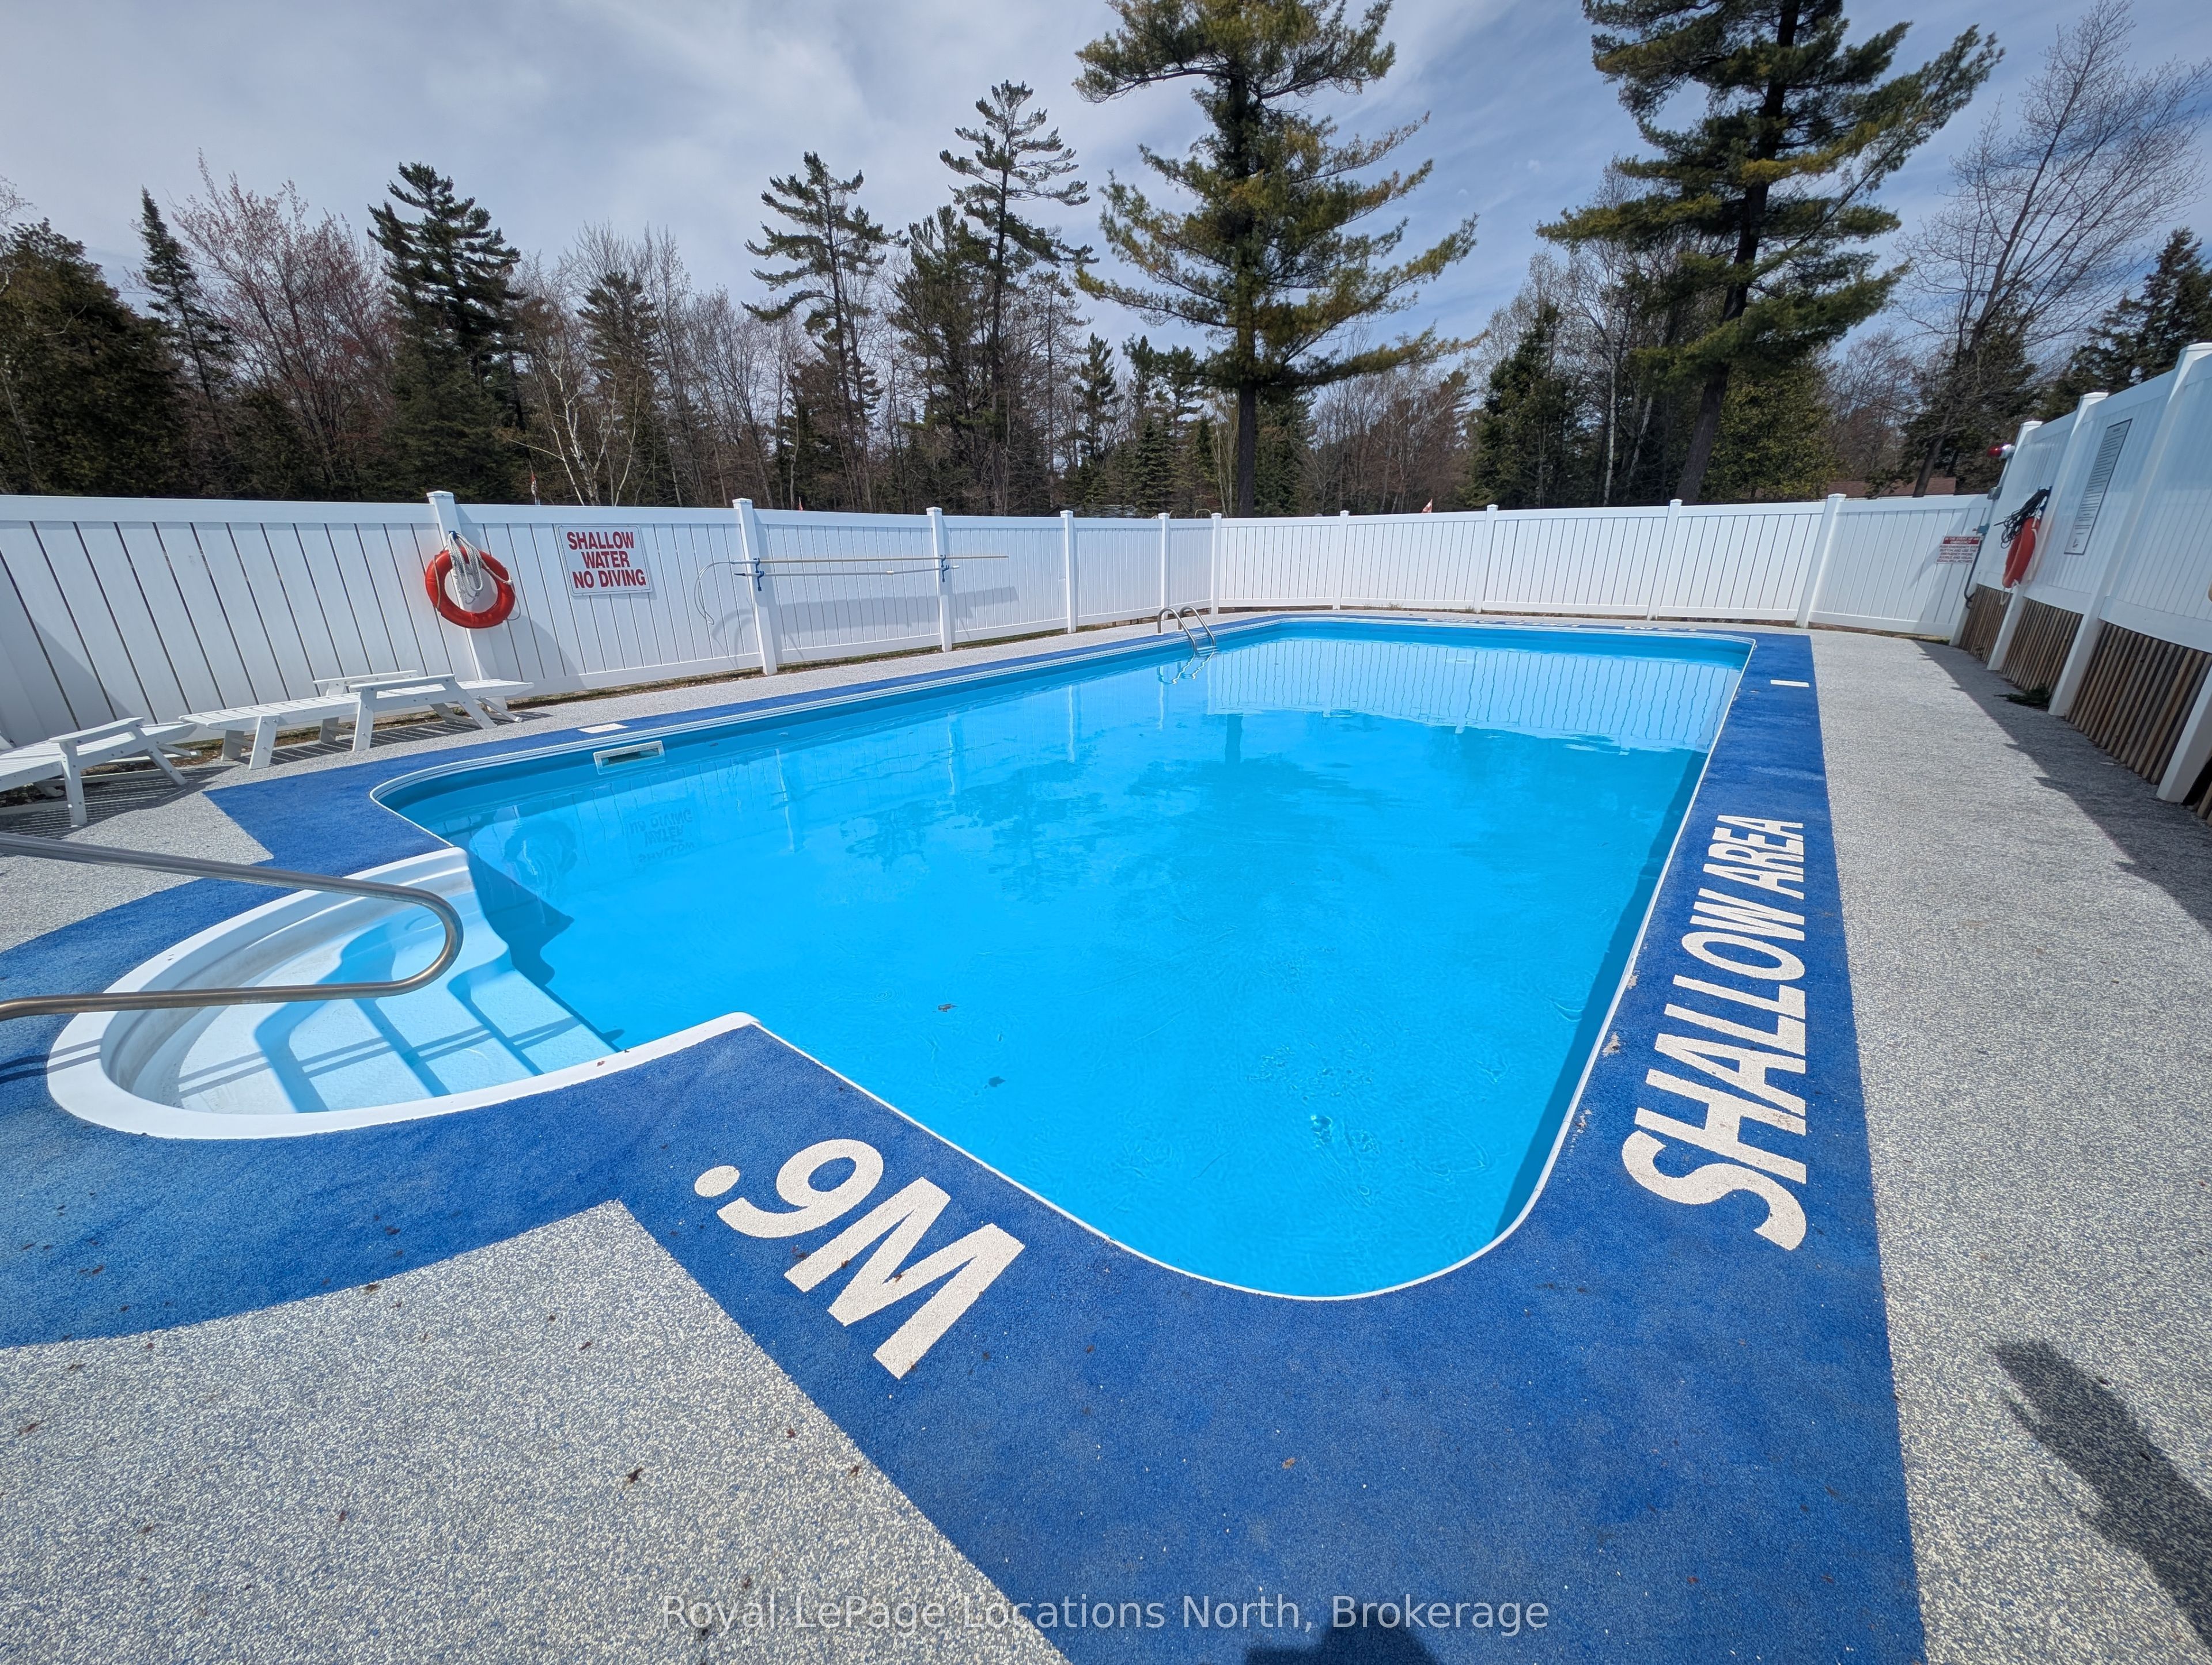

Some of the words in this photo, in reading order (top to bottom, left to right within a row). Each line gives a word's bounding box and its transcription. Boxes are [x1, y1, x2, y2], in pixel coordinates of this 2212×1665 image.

[566, 531, 635, 550] SHALLOW
[581, 551, 631, 568] WATER
[572, 570, 595, 589] NO
[597, 568, 647, 587] DIVING
[1703, 814, 1804, 900] AREA
[1622, 888, 1807, 1251] SHALLOW
